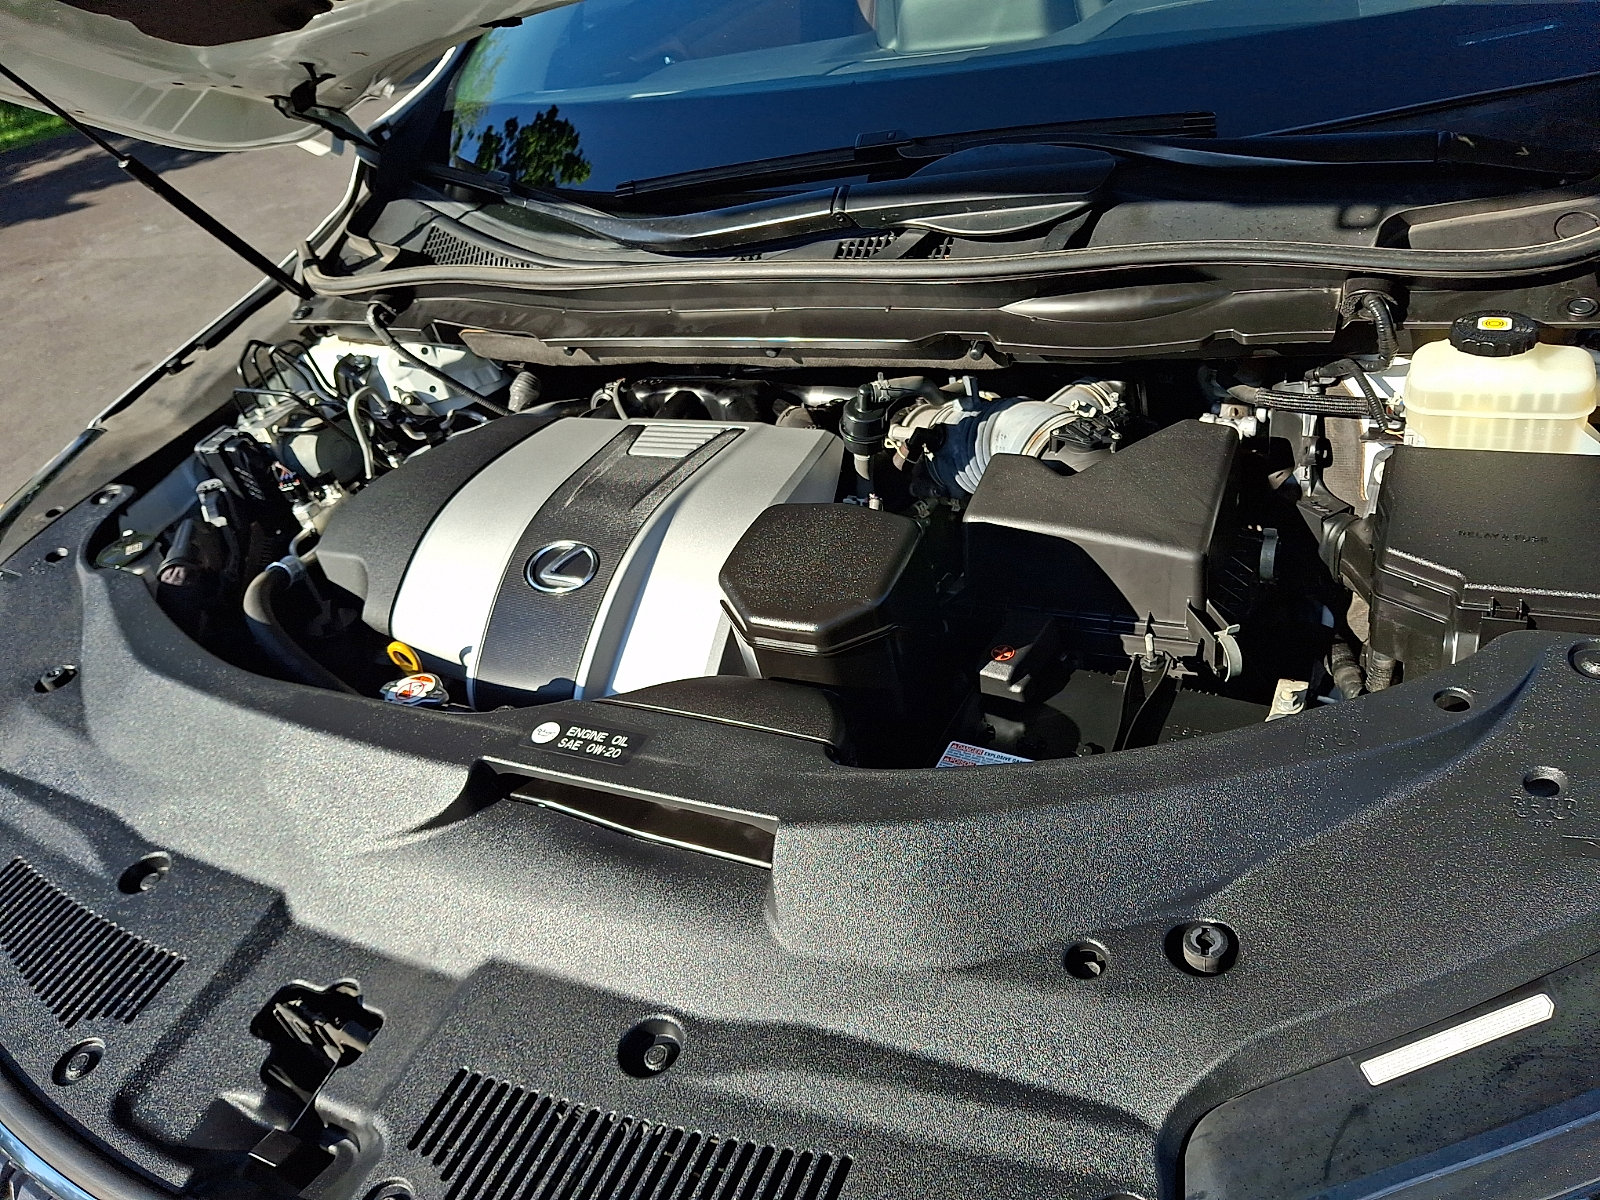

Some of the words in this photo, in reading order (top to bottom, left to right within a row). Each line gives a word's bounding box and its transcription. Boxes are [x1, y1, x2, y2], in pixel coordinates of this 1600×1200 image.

[566, 726, 609, 743] ENGINE
[611, 735, 629, 747] OIL
[557, 738, 583, 751] SAE
[585, 743, 622, 759] 0W-20
[957, 744, 983, 755] DANGER
[984, 751, 1012, 762] EXPLOSIVE
